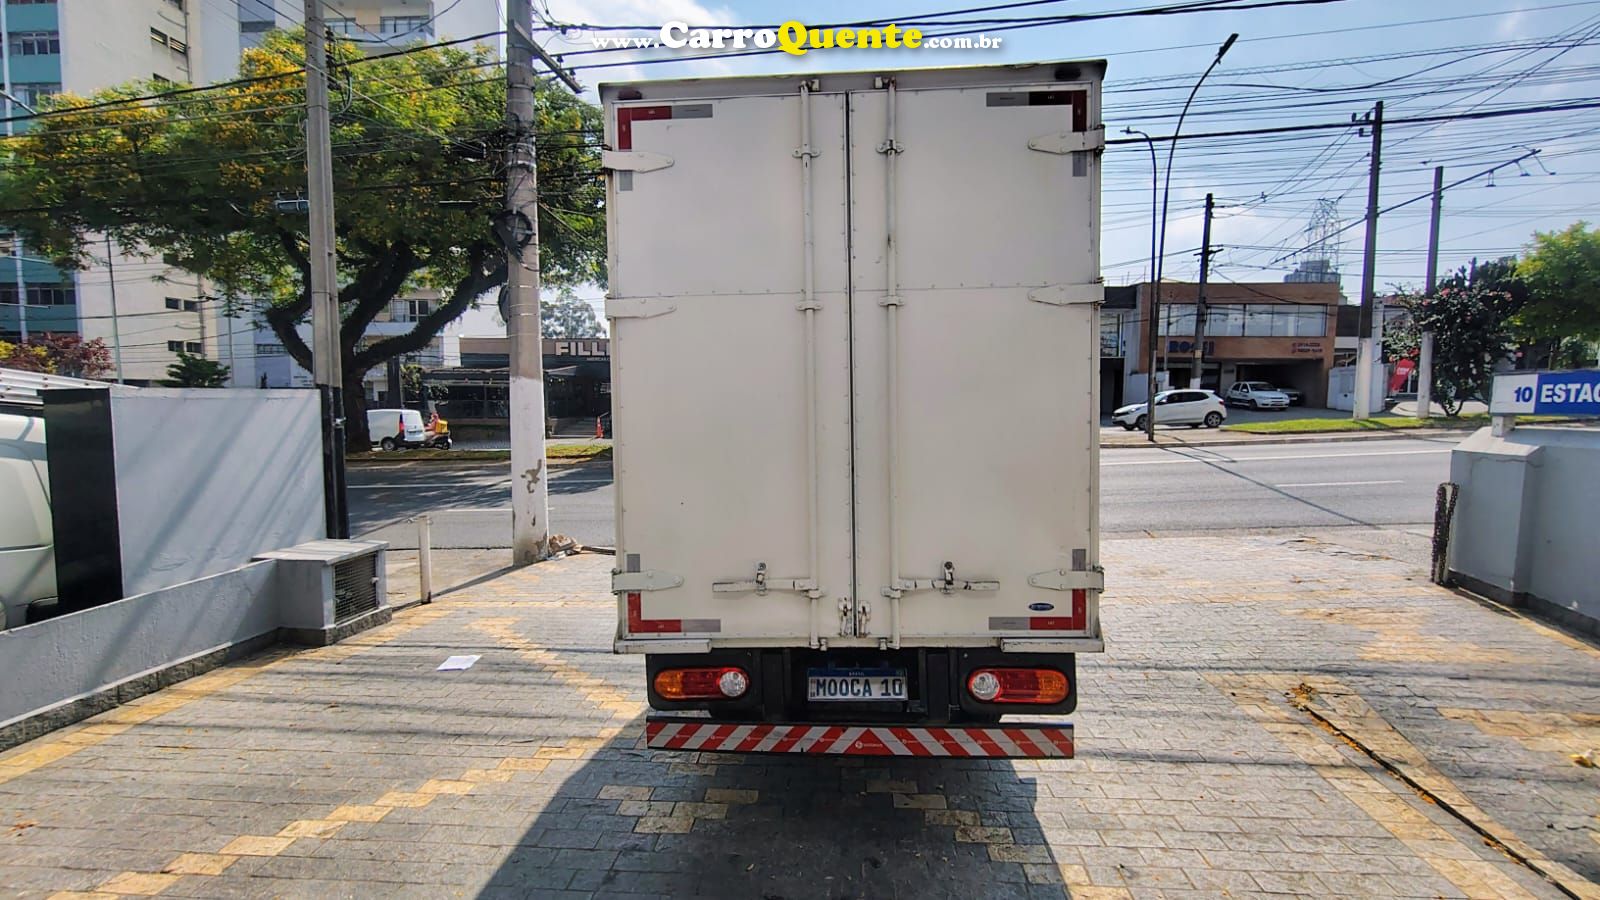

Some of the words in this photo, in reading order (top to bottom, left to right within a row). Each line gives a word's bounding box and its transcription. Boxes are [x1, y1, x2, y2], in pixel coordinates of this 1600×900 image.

[1514, 386, 1534, 403] 10
[816, 678, 873, 697] MOOCA
[880, 678, 903, 697] 10
